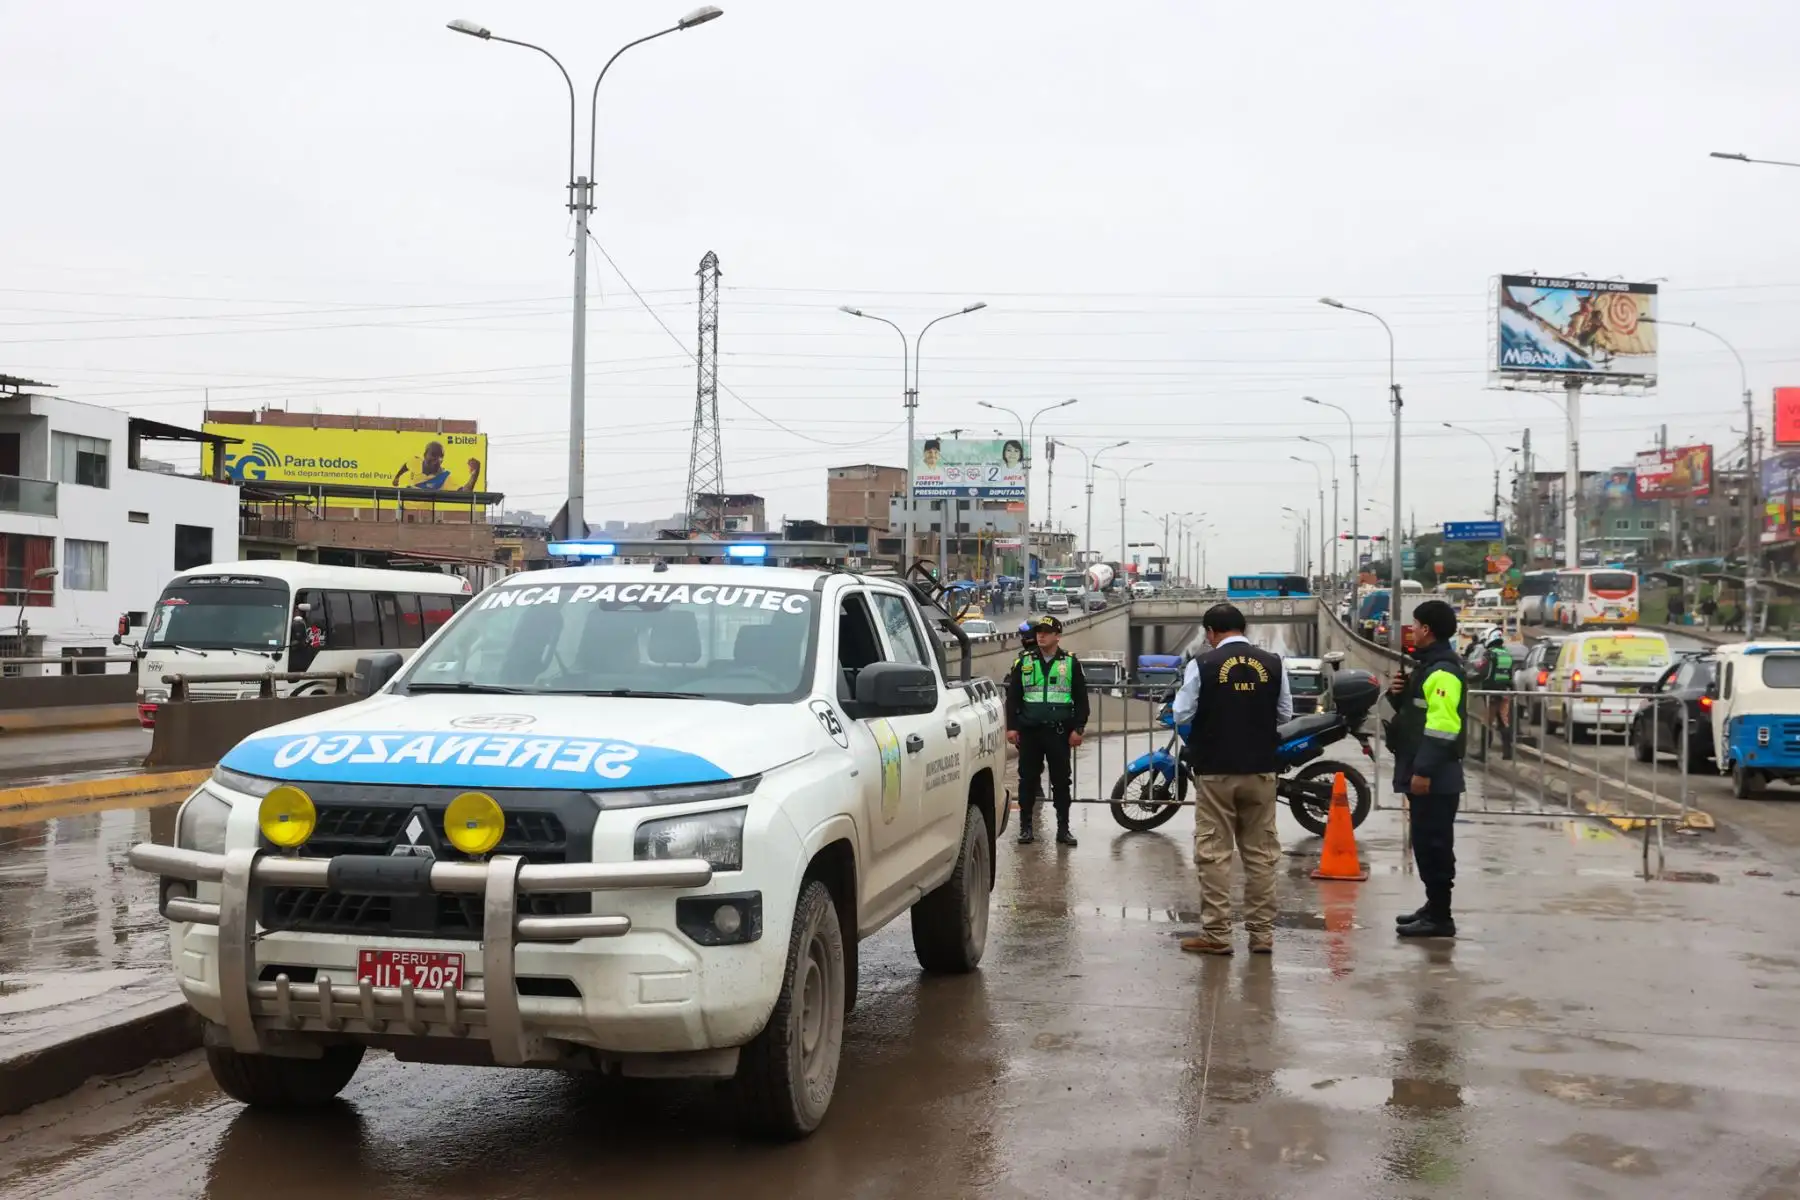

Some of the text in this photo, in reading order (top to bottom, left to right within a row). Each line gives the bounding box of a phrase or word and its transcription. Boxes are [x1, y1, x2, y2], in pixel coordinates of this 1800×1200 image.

[1538, 279, 1548, 287] DE
[1548, 280, 1569, 288] JULIO
[1609, 283, 1630, 291] CINES
[1503, 349, 1562, 365] MOANA
[454, 435, 478, 445] bitel
[284, 455, 358, 469] Para todos
[284, 469, 393, 480] los departamentos del Perú
[988, 467, 999, 482] 2
[914, 488, 957, 496] PRESIDENTE
[988, 488, 1026, 496] DIPUTADA
[479, 583, 811, 615] INCA PACHACUTEC
[818, 709, 842, 736] 25
[392, 952, 429, 965] PERU
